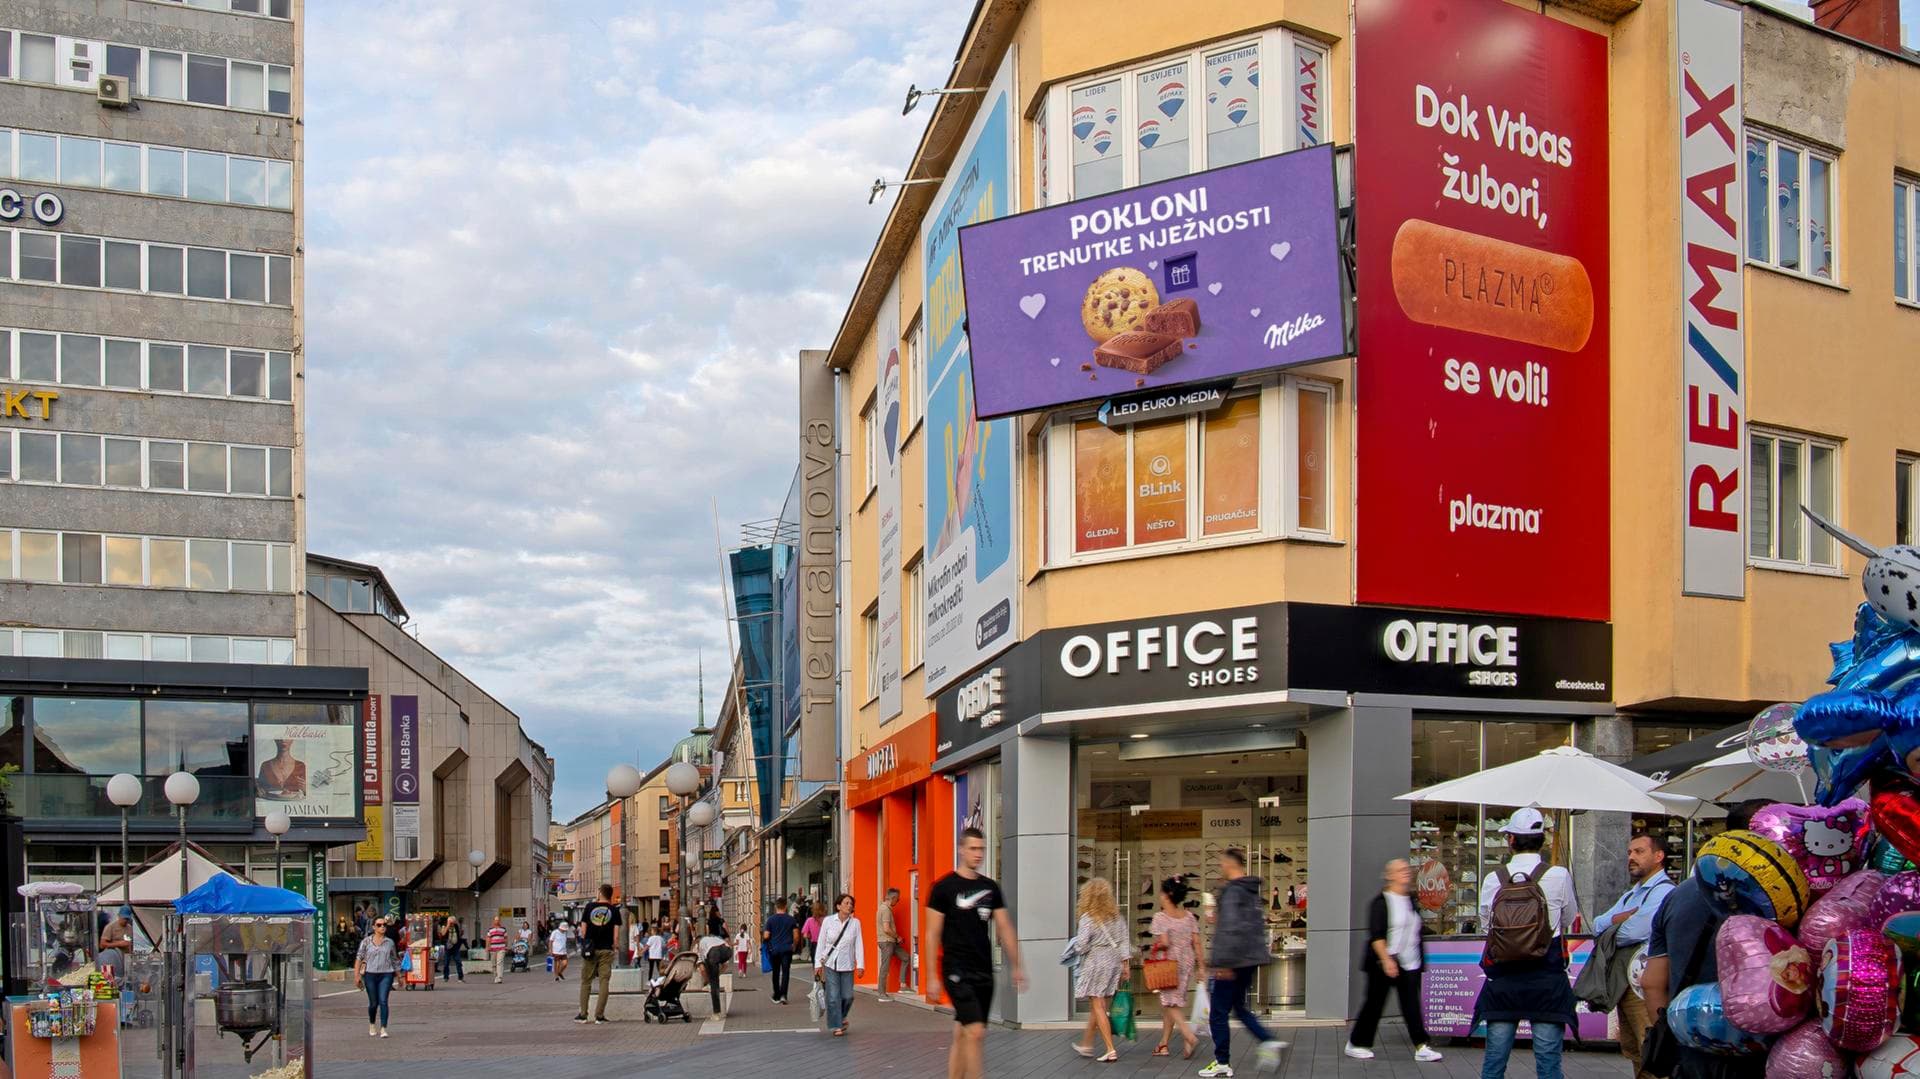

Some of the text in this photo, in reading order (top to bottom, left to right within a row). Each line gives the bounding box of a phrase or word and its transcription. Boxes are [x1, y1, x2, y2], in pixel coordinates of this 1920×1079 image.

[1150, 66, 1182, 82] SVIJETU
[1207, 48, 1257, 67] NEKRETNINA
[1085, 85, 1107, 97] LIDER
[1415, 84, 1573, 168] Dok Vrbas
[1442, 152, 1548, 230] žubori,
[1070, 186, 1208, 240] POKLONI
[1020, 205, 1272, 277] TRENUTKE NJEŽNOSTI
[1264, 312, 1326, 350] Milka
[1444, 358, 1548, 408] se voli!
[1112, 389, 1221, 417] LED EURO MEDIA
[1139, 479, 1182, 497] BLink
[1086, 526, 1120, 539] GLEDAJ
[1147, 518, 1176, 532] NEŠTO
[1205, 508, 1257, 523] DRUGAČIJE
[1450, 493, 1540, 534] plazma
[928, 564, 951, 600] Mikrofin
[952, 546, 968, 581] robni
[928, 579, 964, 628] mikrokrediti
[1061, 616, 1259, 678] OFFICE
[1383, 619, 1518, 667] OFFICE
[1187, 666, 1259, 688] SHOES
[1469, 672, 1518, 687] SHOES
[1555, 680, 1606, 691] officeshoes.ba
[364, 720, 377, 768] Juventa
[401, 715, 411, 770] NLB Banka
[284, 804, 329, 815] DAMIANI
[1210, 818, 1241, 828] GUESS
[317, 910, 325, 968] BANKOMAT
